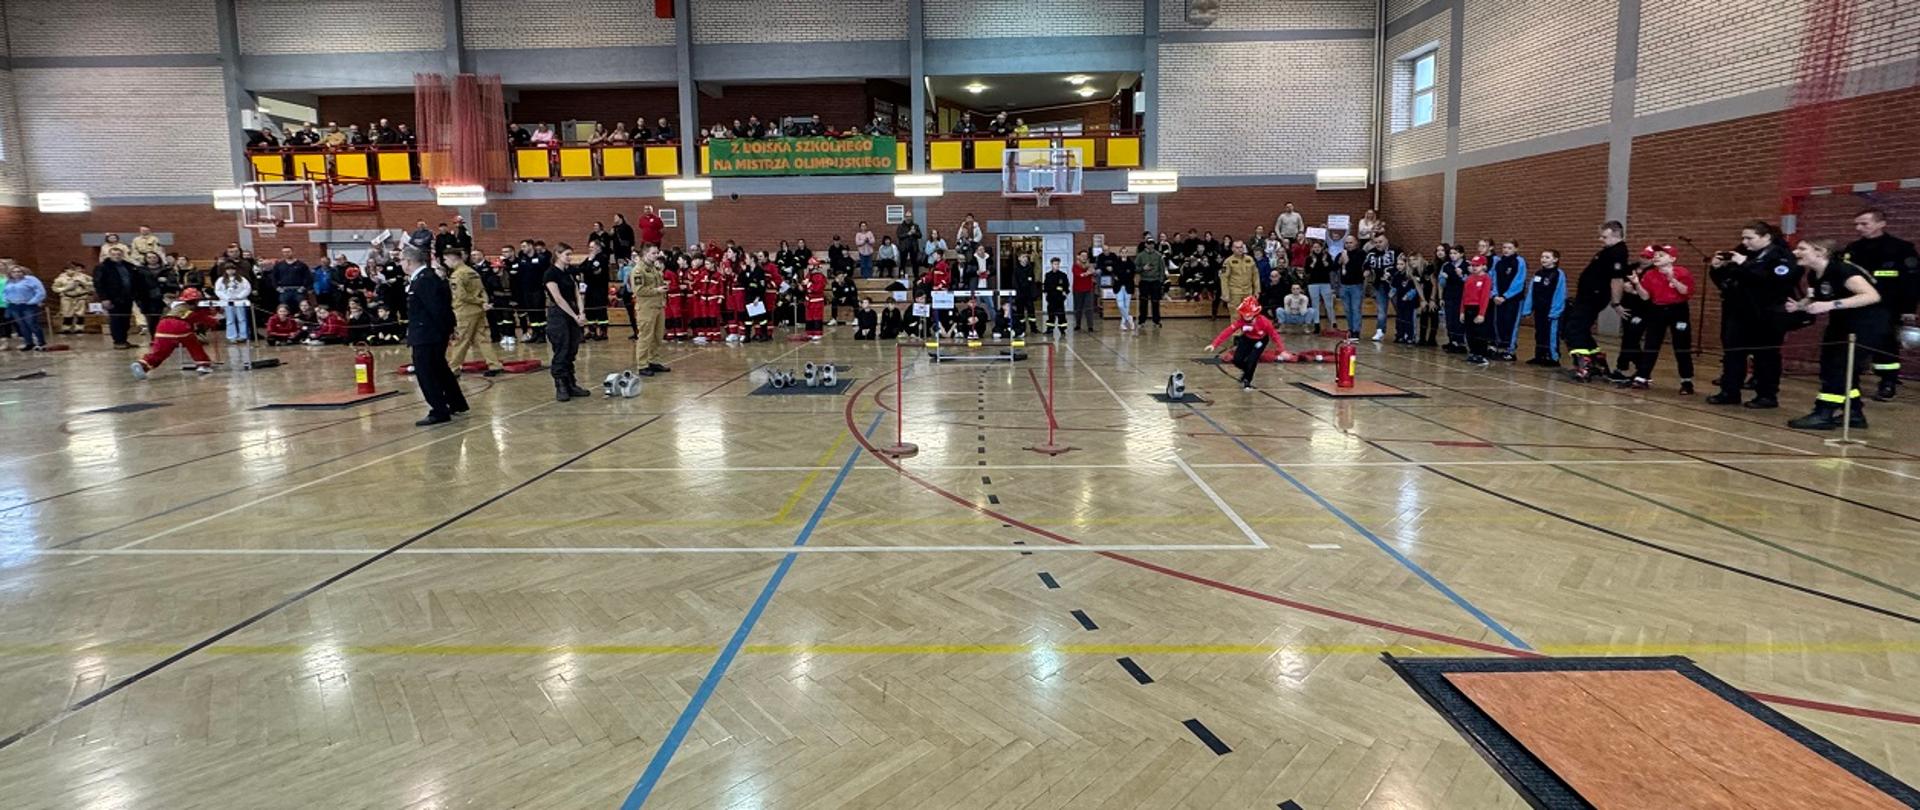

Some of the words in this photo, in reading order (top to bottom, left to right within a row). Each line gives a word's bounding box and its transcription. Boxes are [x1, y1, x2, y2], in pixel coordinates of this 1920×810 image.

[730, 142, 741, 155] Z
[743, 141, 793, 154] BOISKA
[795, 139, 873, 153] SZKOLNEGO
[713, 159, 733, 171] NA
[735, 157, 790, 170] MISTRZA
[793, 156, 892, 169] OLIMPIJSKIEGO
